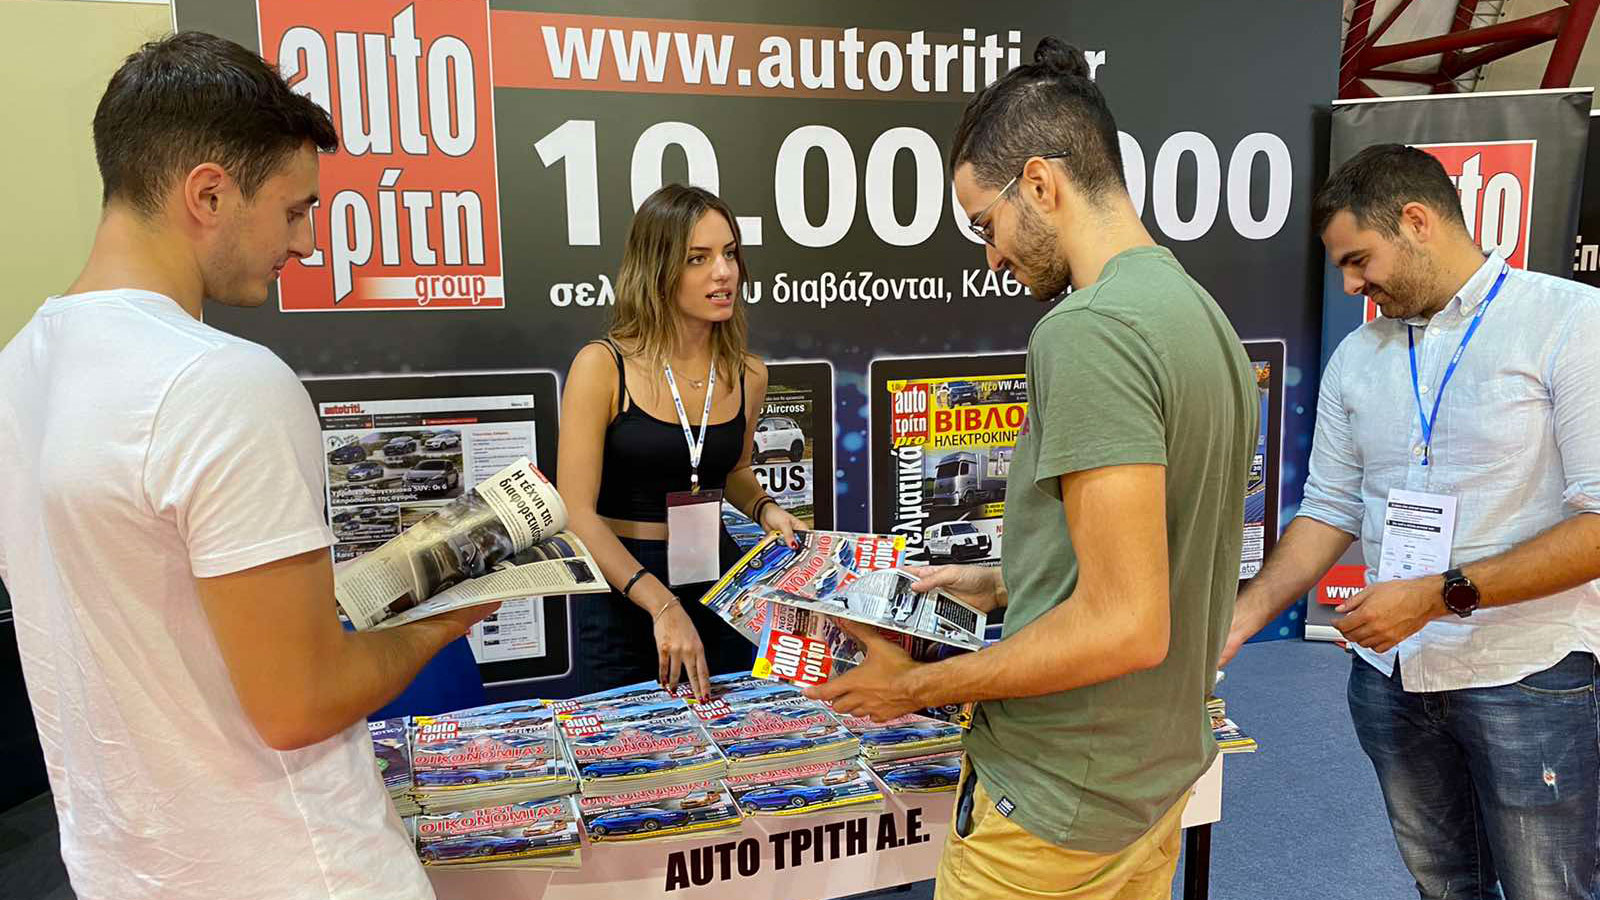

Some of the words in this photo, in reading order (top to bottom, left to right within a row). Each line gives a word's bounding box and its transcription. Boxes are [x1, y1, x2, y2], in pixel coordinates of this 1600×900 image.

[541, 25, 1106, 93] www.autotritir
[278, 2, 476, 157] auto
[1450, 152, 1523, 260] to
[415, 275, 486, 305] group
[550, 274, 616, 307] σελ
[772, 271, 952, 308] διαβάζονται,
[963, 269, 1032, 298] ΚΑΘ
[998, 380, 1012, 391] VW
[1013, 379, 1028, 389] Am
[766, 403, 805, 414] Aircross
[895, 386, 926, 414] auto
[895, 414, 926, 437] τρίτη
[935, 405, 1025, 433] ΒΙΒΛΟ
[893, 436, 926, 449] pro
[935, 430, 1019, 447] ΗΛΕΚΤΡΟΚΙΝΗ
[511, 469, 526, 481] Η
[520, 479, 546, 510] τέχνη
[541, 508, 554, 527] της
[874, 540, 895, 569] auto
[771, 635, 804, 678] auto
[801, 641, 828, 683] τρίτη
[693, 699, 724, 712] auto
[423, 723, 456, 734] auto
[565, 715, 598, 728] auto
[567, 725, 601, 736] τρίτη
[421, 732, 455, 743] τρίτη
[419, 806, 562, 834] ΟΙΚΟΝΟΜΙΑΣ
[665, 837, 760, 891] AUTO
